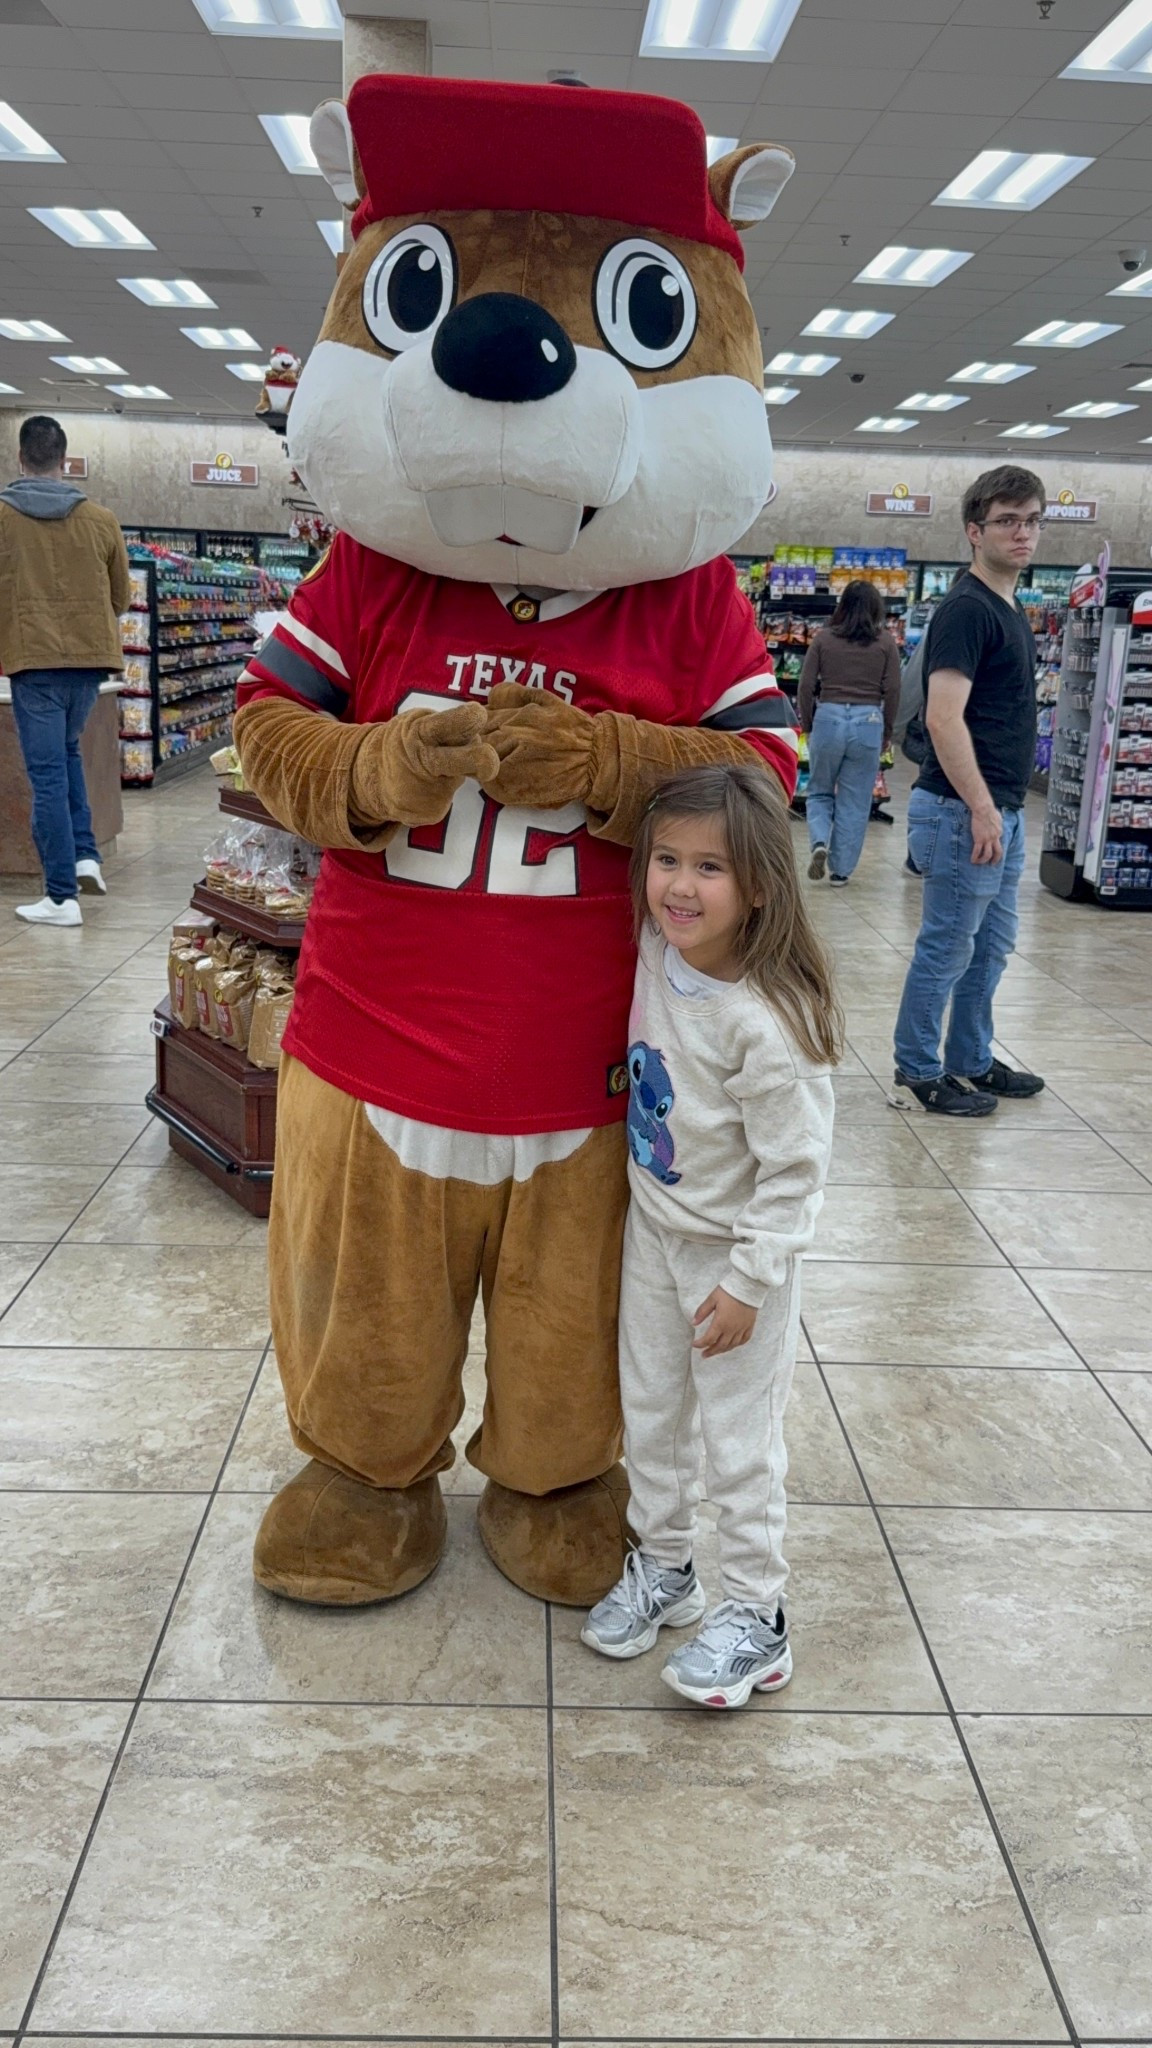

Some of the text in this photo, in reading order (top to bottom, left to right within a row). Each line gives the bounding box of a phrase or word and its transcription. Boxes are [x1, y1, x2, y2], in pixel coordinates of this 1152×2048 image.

[206, 468, 243, 482] JUICE
[884, 499, 916, 512] WINE
[1043, 505, 1090, 518] MPORTS
[446, 653, 577, 705] TEXAS
